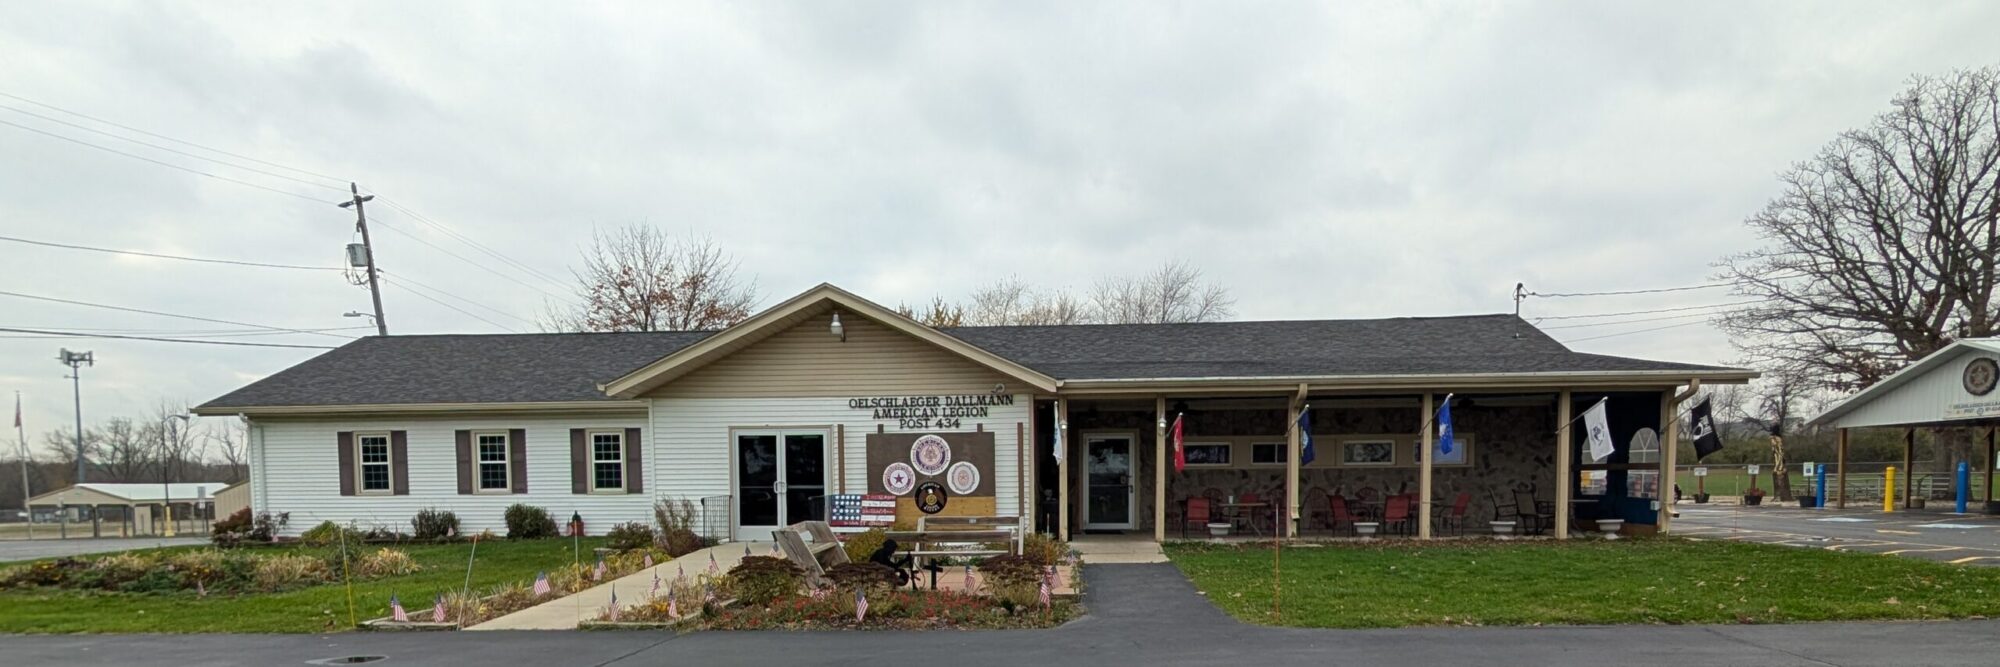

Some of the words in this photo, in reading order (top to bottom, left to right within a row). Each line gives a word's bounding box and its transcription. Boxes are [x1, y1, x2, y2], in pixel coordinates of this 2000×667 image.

[849, 396, 941, 409] OELSCHLAEGER
[945, 394, 1014, 407] DALLMANN
[872, 407, 938, 419] AMERICAN
[943, 406, 988, 417] LEGION
[900, 418, 930, 429] POST
[935, 418, 960, 428] 434
